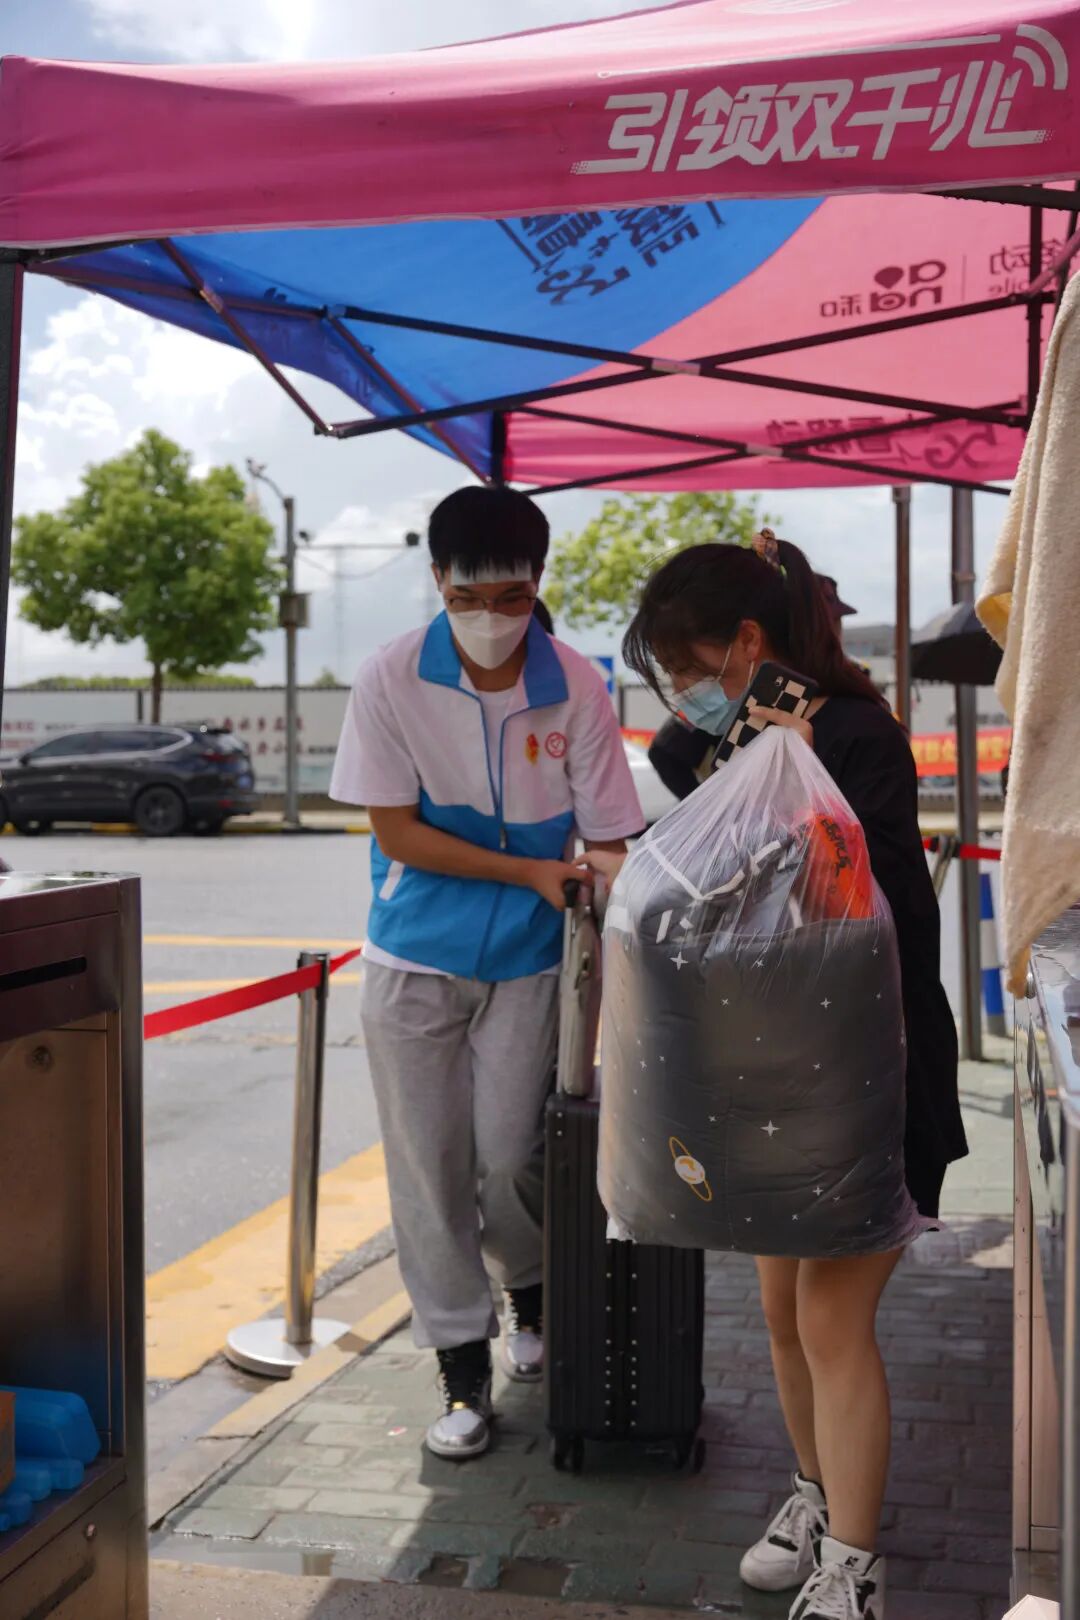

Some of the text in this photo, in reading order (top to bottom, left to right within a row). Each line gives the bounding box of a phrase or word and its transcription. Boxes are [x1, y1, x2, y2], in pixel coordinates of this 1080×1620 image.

[571, 61, 1053, 174] 引领双千兆
